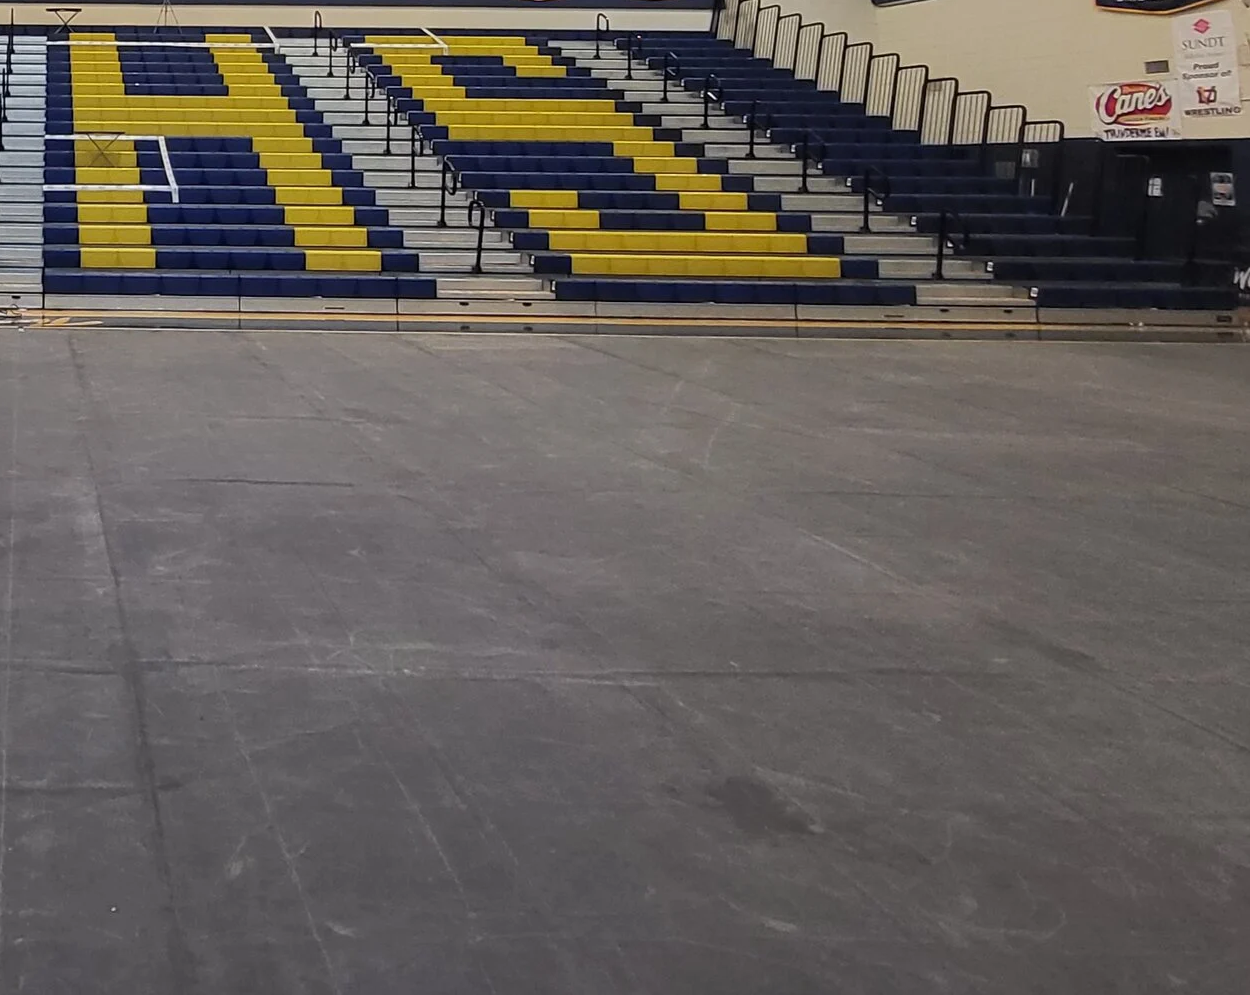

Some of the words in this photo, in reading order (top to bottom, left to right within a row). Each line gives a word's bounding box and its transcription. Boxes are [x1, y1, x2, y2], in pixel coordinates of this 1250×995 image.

[1182, 36, 1226, 50] SUNDT
[1193, 62, 1219, 70] Proud
[1182, 72, 1219, 81] Sponsor
[1099, 81, 1170, 124] Cane's
[1184, 107, 1242, 116] WRESTLING
